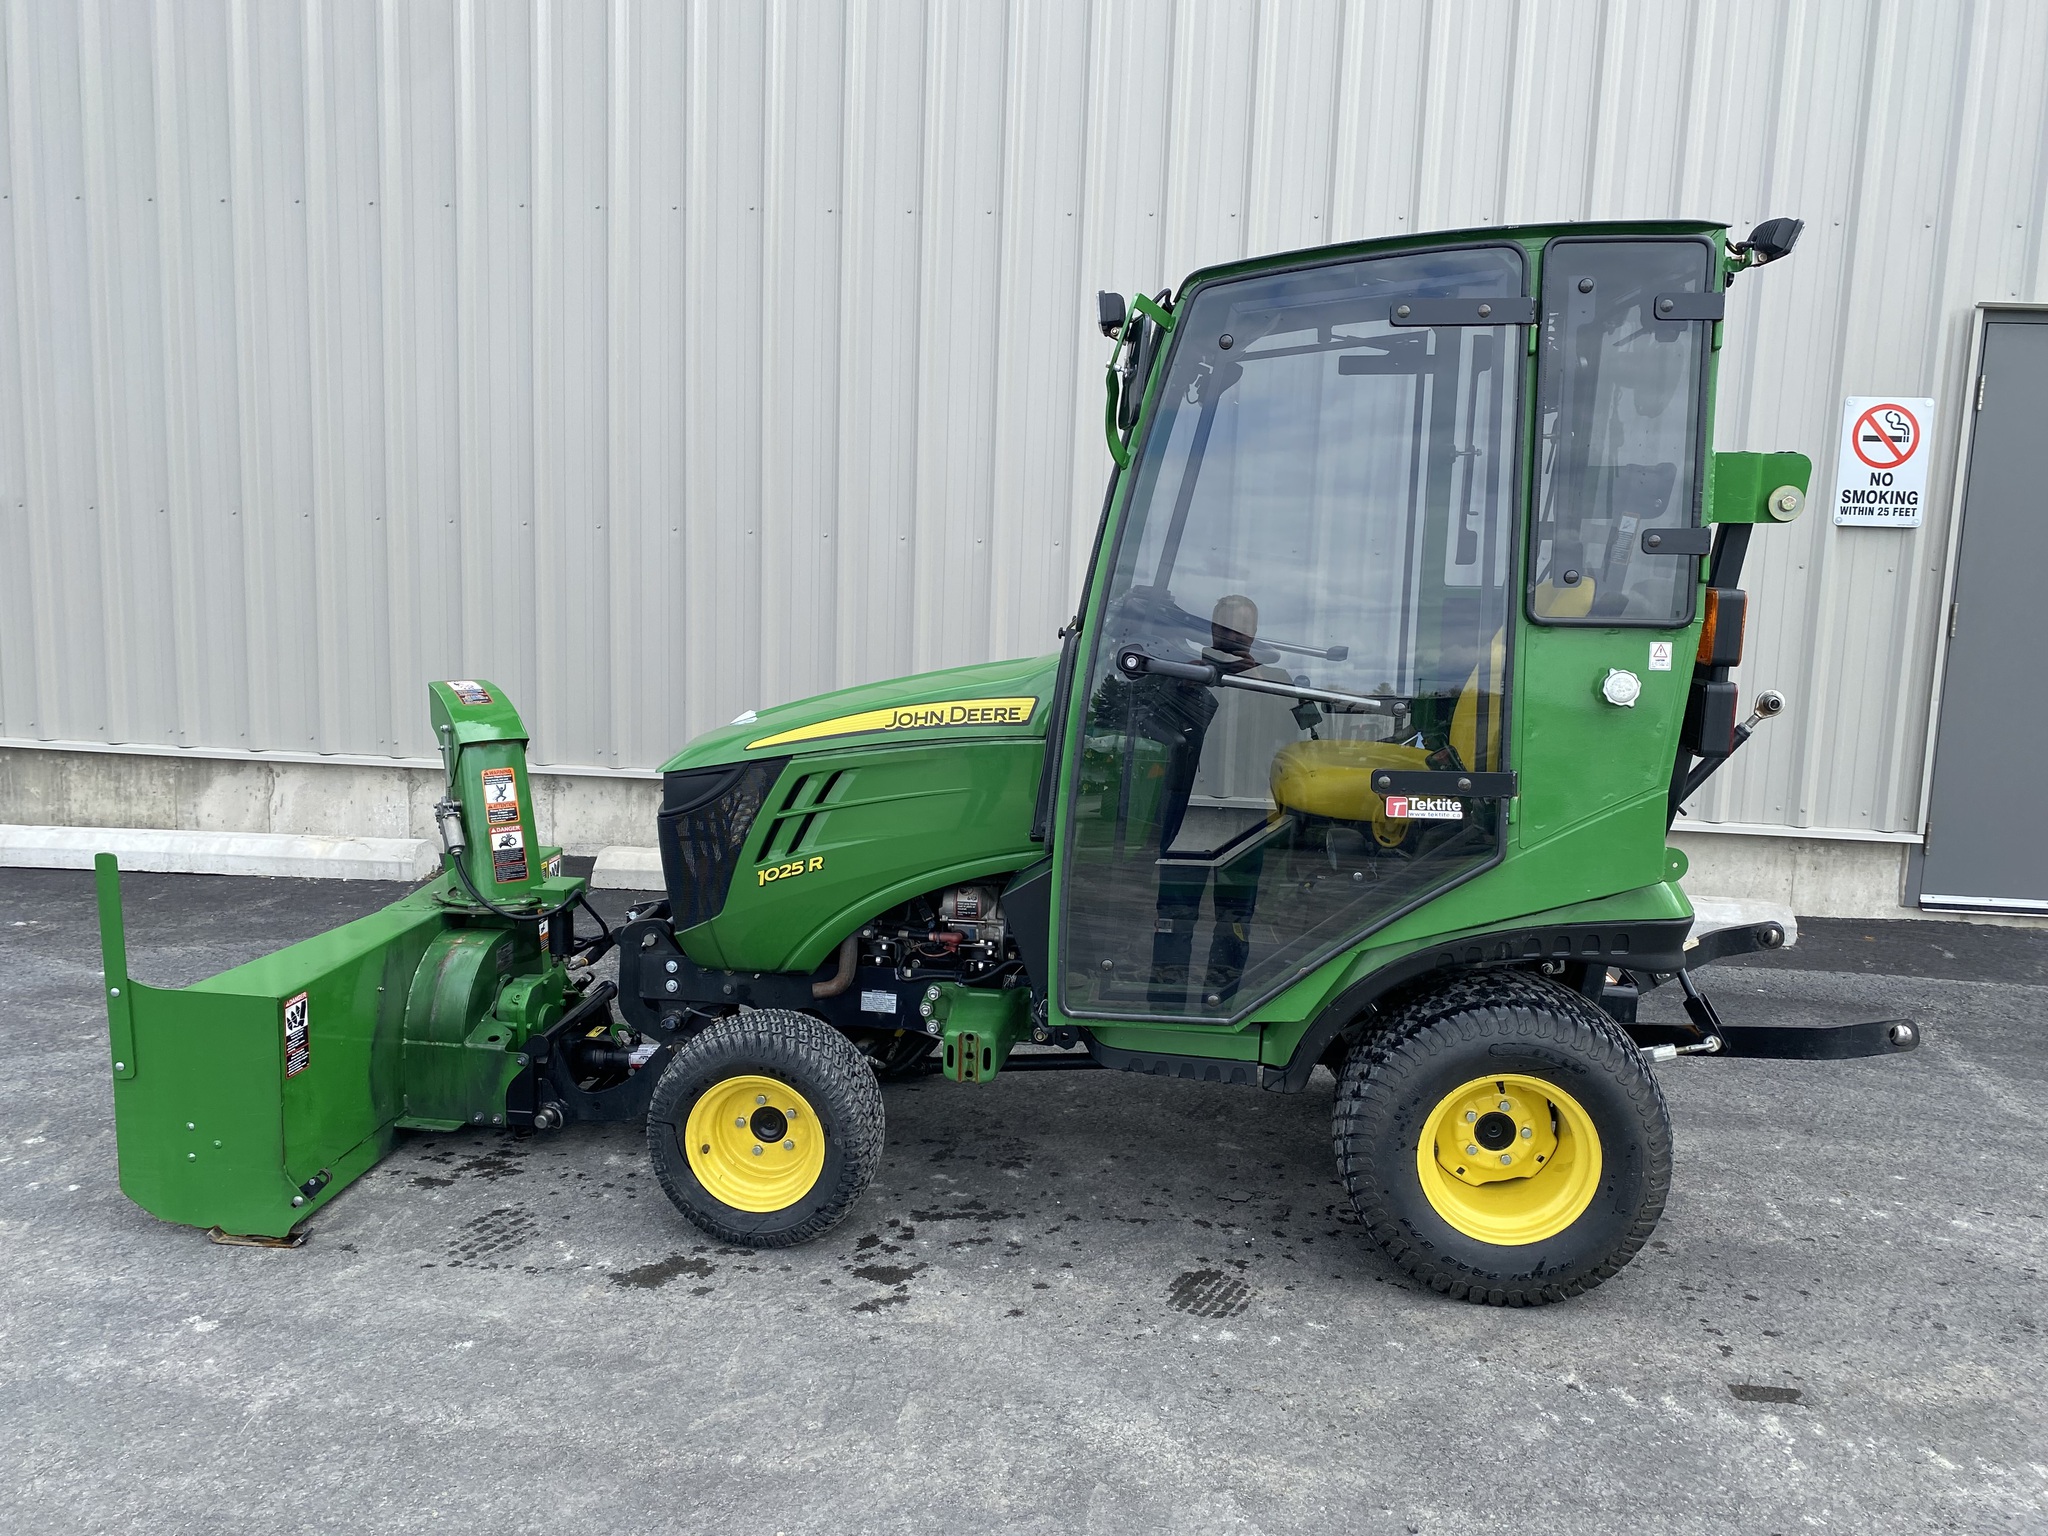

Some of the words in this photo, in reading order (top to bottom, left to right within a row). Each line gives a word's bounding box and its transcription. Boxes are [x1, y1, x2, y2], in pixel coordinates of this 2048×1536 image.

[1869, 472, 1894, 487] NO
[1841, 489, 1919, 505] SMOKING
[1840, 506, 1875, 516] WITHIN
[1877, 507, 1890, 517] 25
[1892, 507, 1918, 517] FEET
[884, 709, 945, 729] JOHN
[949, 706, 1022, 723] DEERE
[1408, 797, 1462, 812] Tektite
[496, 825, 520, 833] DANGER
[757, 860, 805, 887] 1025
[808, 856, 824, 872] R
